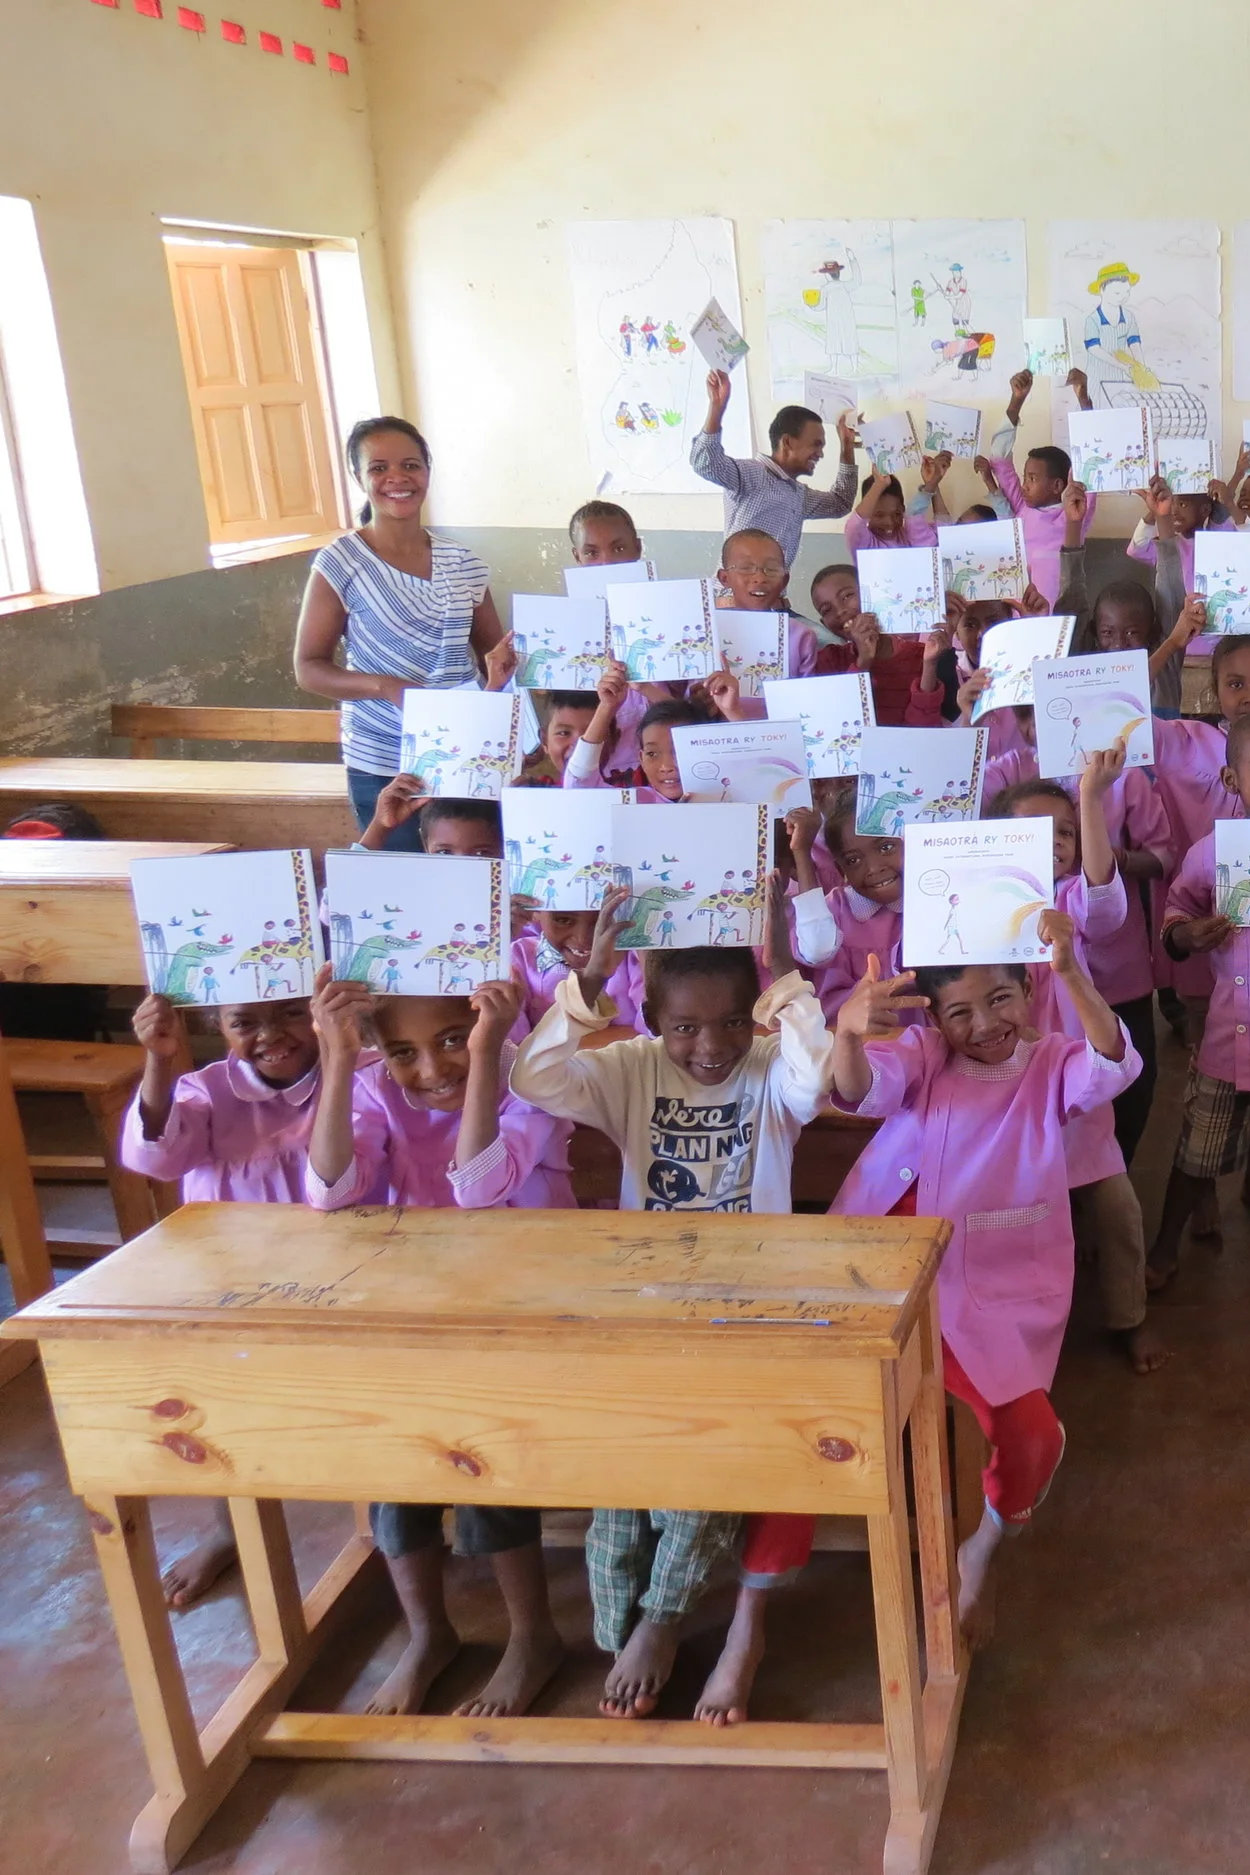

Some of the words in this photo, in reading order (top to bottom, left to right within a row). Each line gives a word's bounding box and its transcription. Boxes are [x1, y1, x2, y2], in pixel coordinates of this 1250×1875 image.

[1047, 668, 1092, 680] MISAOTRA
[1111, 664, 1135, 674] TOKY!
[690, 736, 739, 747] MISAOTRA
[744, 736, 756, 744] RY
[761, 733, 788, 742] TOKY!
[923, 836, 979, 848] MISAOTRA
[984, 835, 998, 844] RY
[1004, 833, 1035, 844] TOKY!
